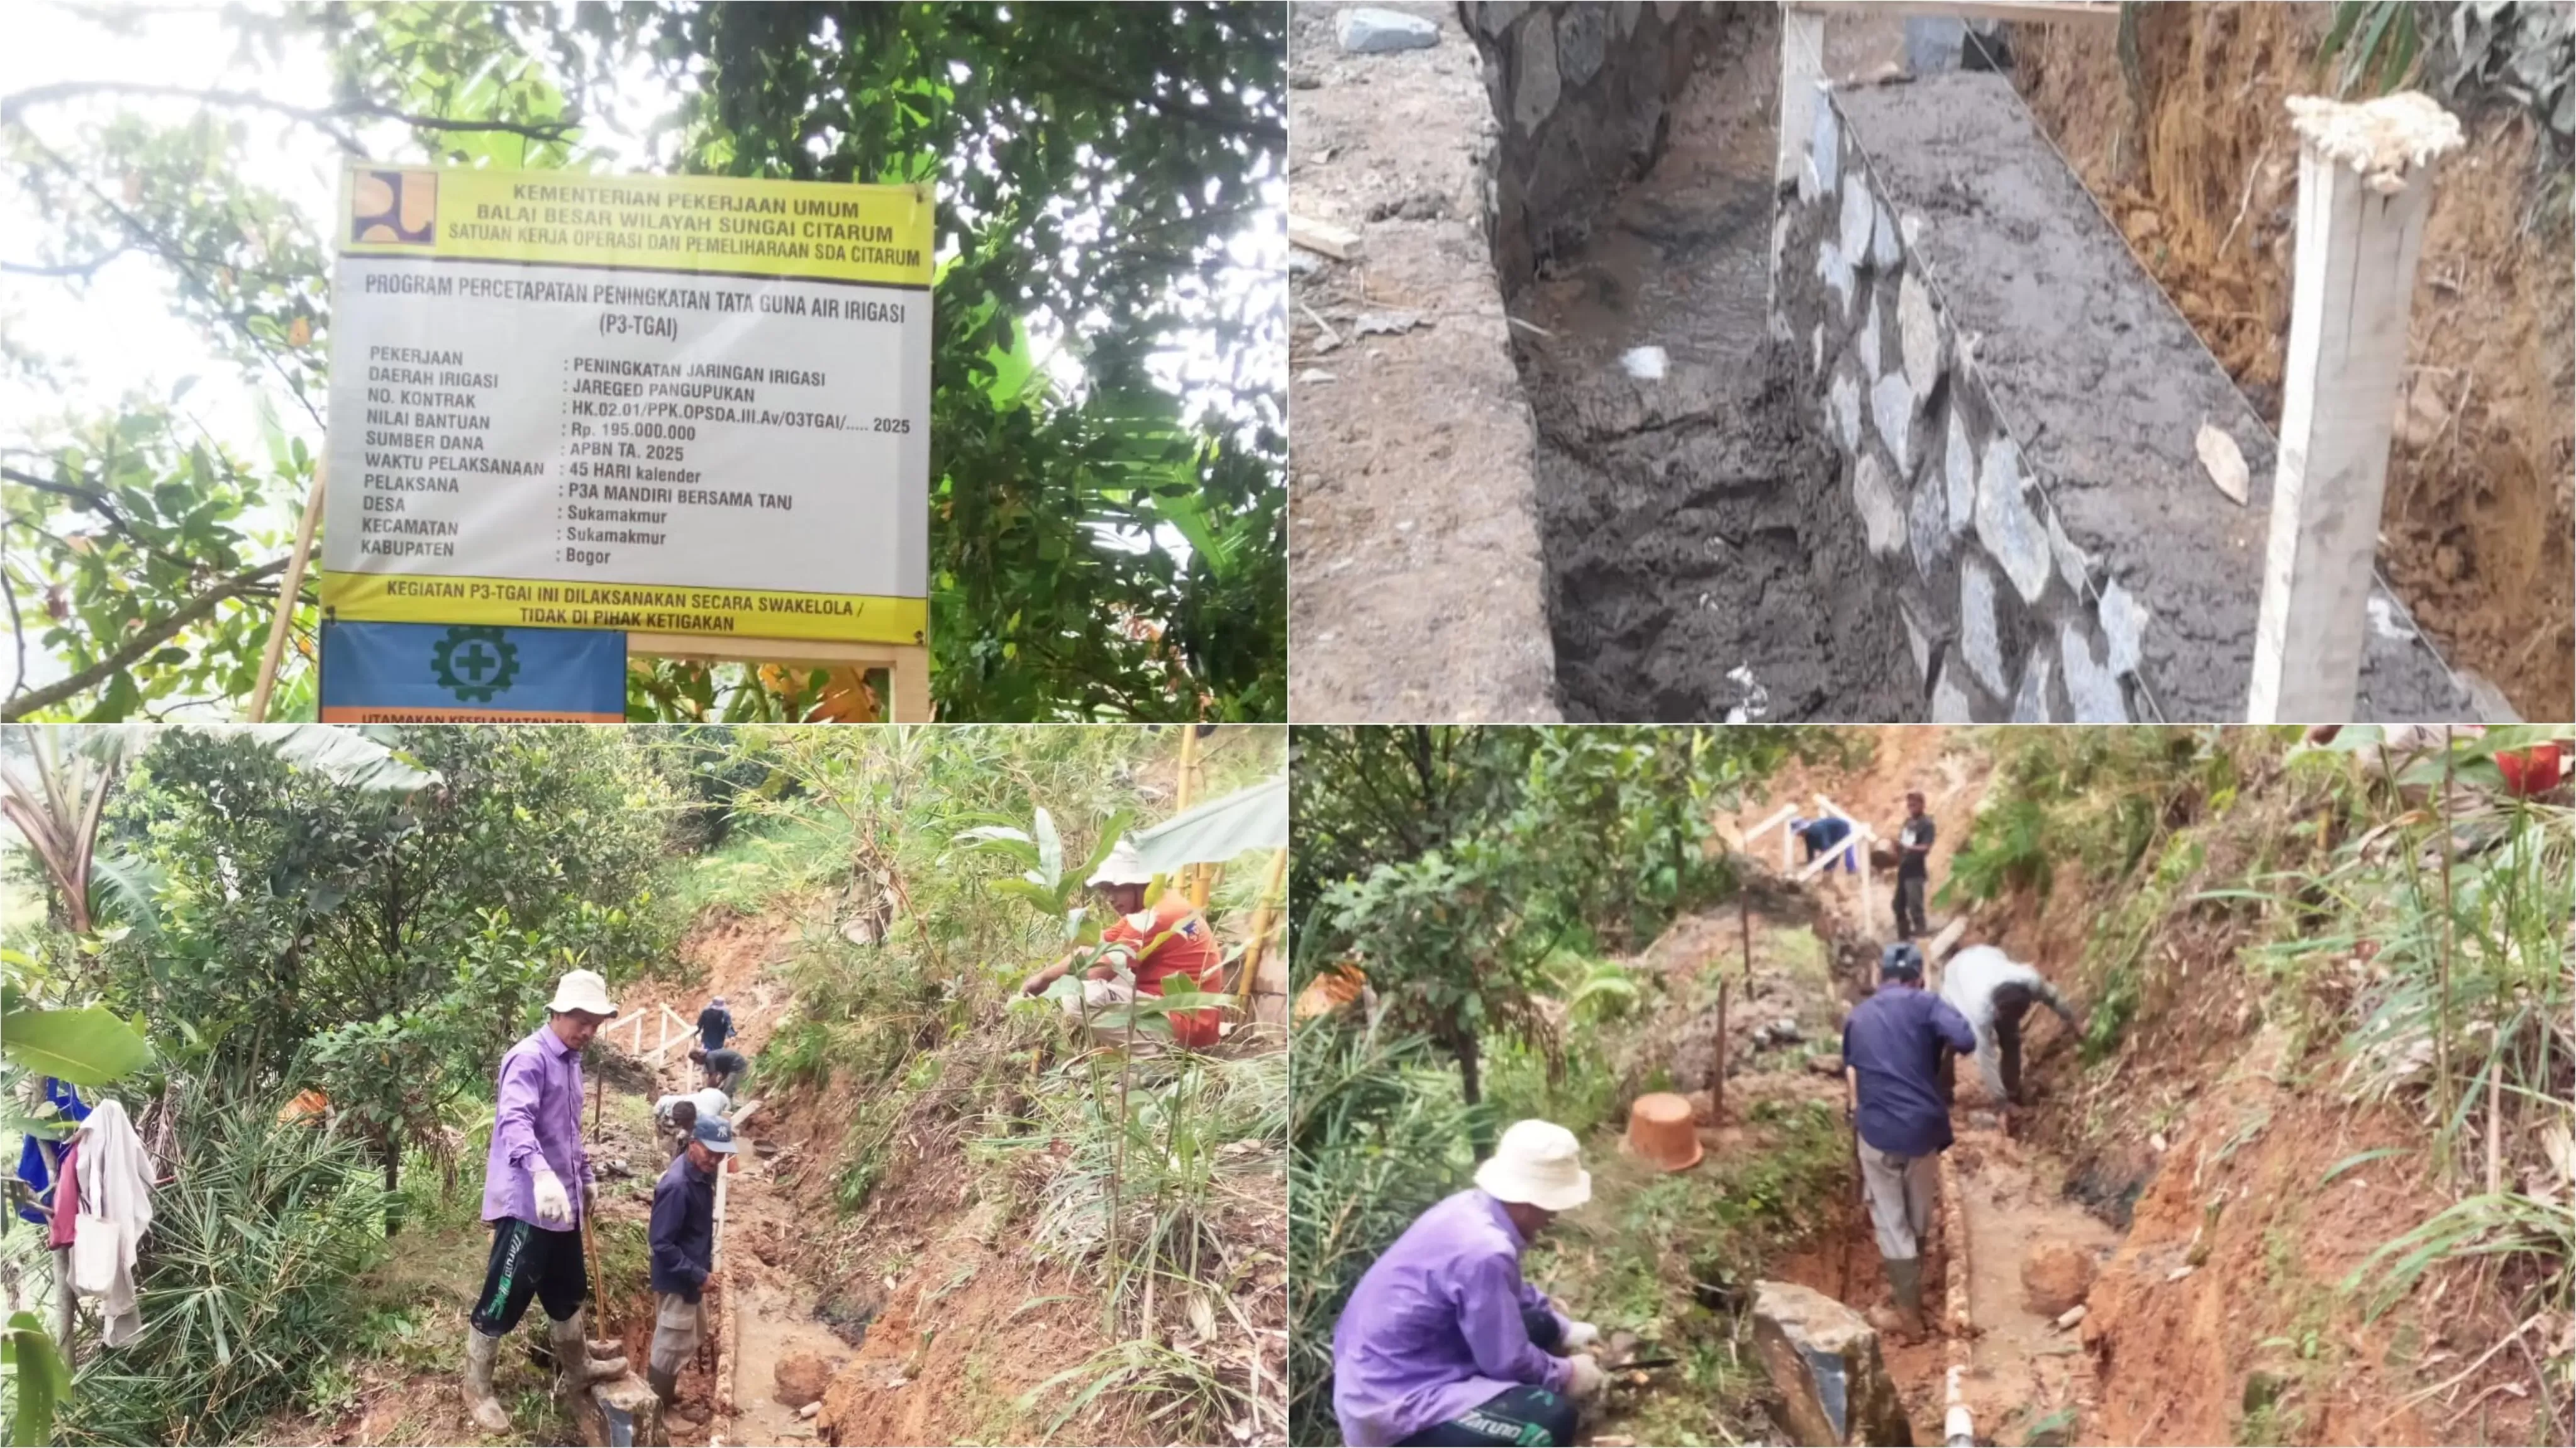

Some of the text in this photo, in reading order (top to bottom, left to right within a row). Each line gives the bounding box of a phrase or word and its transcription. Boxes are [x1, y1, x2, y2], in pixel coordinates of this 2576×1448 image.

[514, 184, 858, 218] KEMENTERIAN PEKERJAAN UMUM
[477, 203, 893, 243] BALAI BESAR WILAYAH SUNGAI CITARUM
[449, 223, 920, 267] SATUAN KERJA OPERASI DAN PEMELIHARAAN SDA CITARUM
[365, 274, 905, 323] PROGRAM PERCETAPATAN PENINGKATAN TATA GUNA AIR IRIGASI
[599, 313, 678, 342] (P3-TGAI)
[370, 346, 463, 366] PEKERJAAN
[369, 366, 498, 388] DAERAH IRIGASI
[574, 357, 681, 378] PENINGKATAN
[687, 363, 764, 383] JARINGAN
[769, 368, 825, 387] IRIGASI
[368, 387, 476, 408] NO. KONTRAK
[573, 379, 643, 397] JAREGED
[649, 382, 754, 403] PANGUPUKAN
[367, 409, 490, 430] NILAI BANTUAN
[874, 417, 910, 433] 2025
[365, 430, 484, 451] SUMBER DANA
[571, 421, 596, 439] Rp.
[602, 423, 696, 441] 195.000.000
[570, 442, 613, 457] APBN
[618, 442, 640, 459] TA.
[646, 444, 684, 462] 2025
[365, 452, 545, 476] WAKTU PELAKSANAAN
[570, 462, 588, 477] 45
[594, 462, 631, 479] HARI
[636, 465, 701, 484] kalender
[364, 474, 459, 493] PELAKSANA
[363, 495, 405, 512] DESA
[569, 482, 599, 499] P3A
[604, 485, 672, 503] MANDIRI
[677, 489, 753, 508] BERSAMA
[758, 493, 792, 510] TANJ
[568, 504, 667, 524] Sukamakmur
[362, 517, 458, 537] KECAMATAN
[567, 526, 666, 545] Sukamakmur
[361, 539, 454, 557] KABUPATEN
[566, 547, 611, 567] Bogor
[387, 580, 464, 598] KEGIATAN
[470, 583, 531, 601] P3-TGAI
[538, 585, 558, 603] INI
[565, 587, 686, 608] DILAKSANAKAN
[692, 593, 753, 612] SECARA
[758, 596, 853, 616] SWAKELOLA
[520, 607, 734, 632] TIDAK DI PIHAK KETIGAKAN
